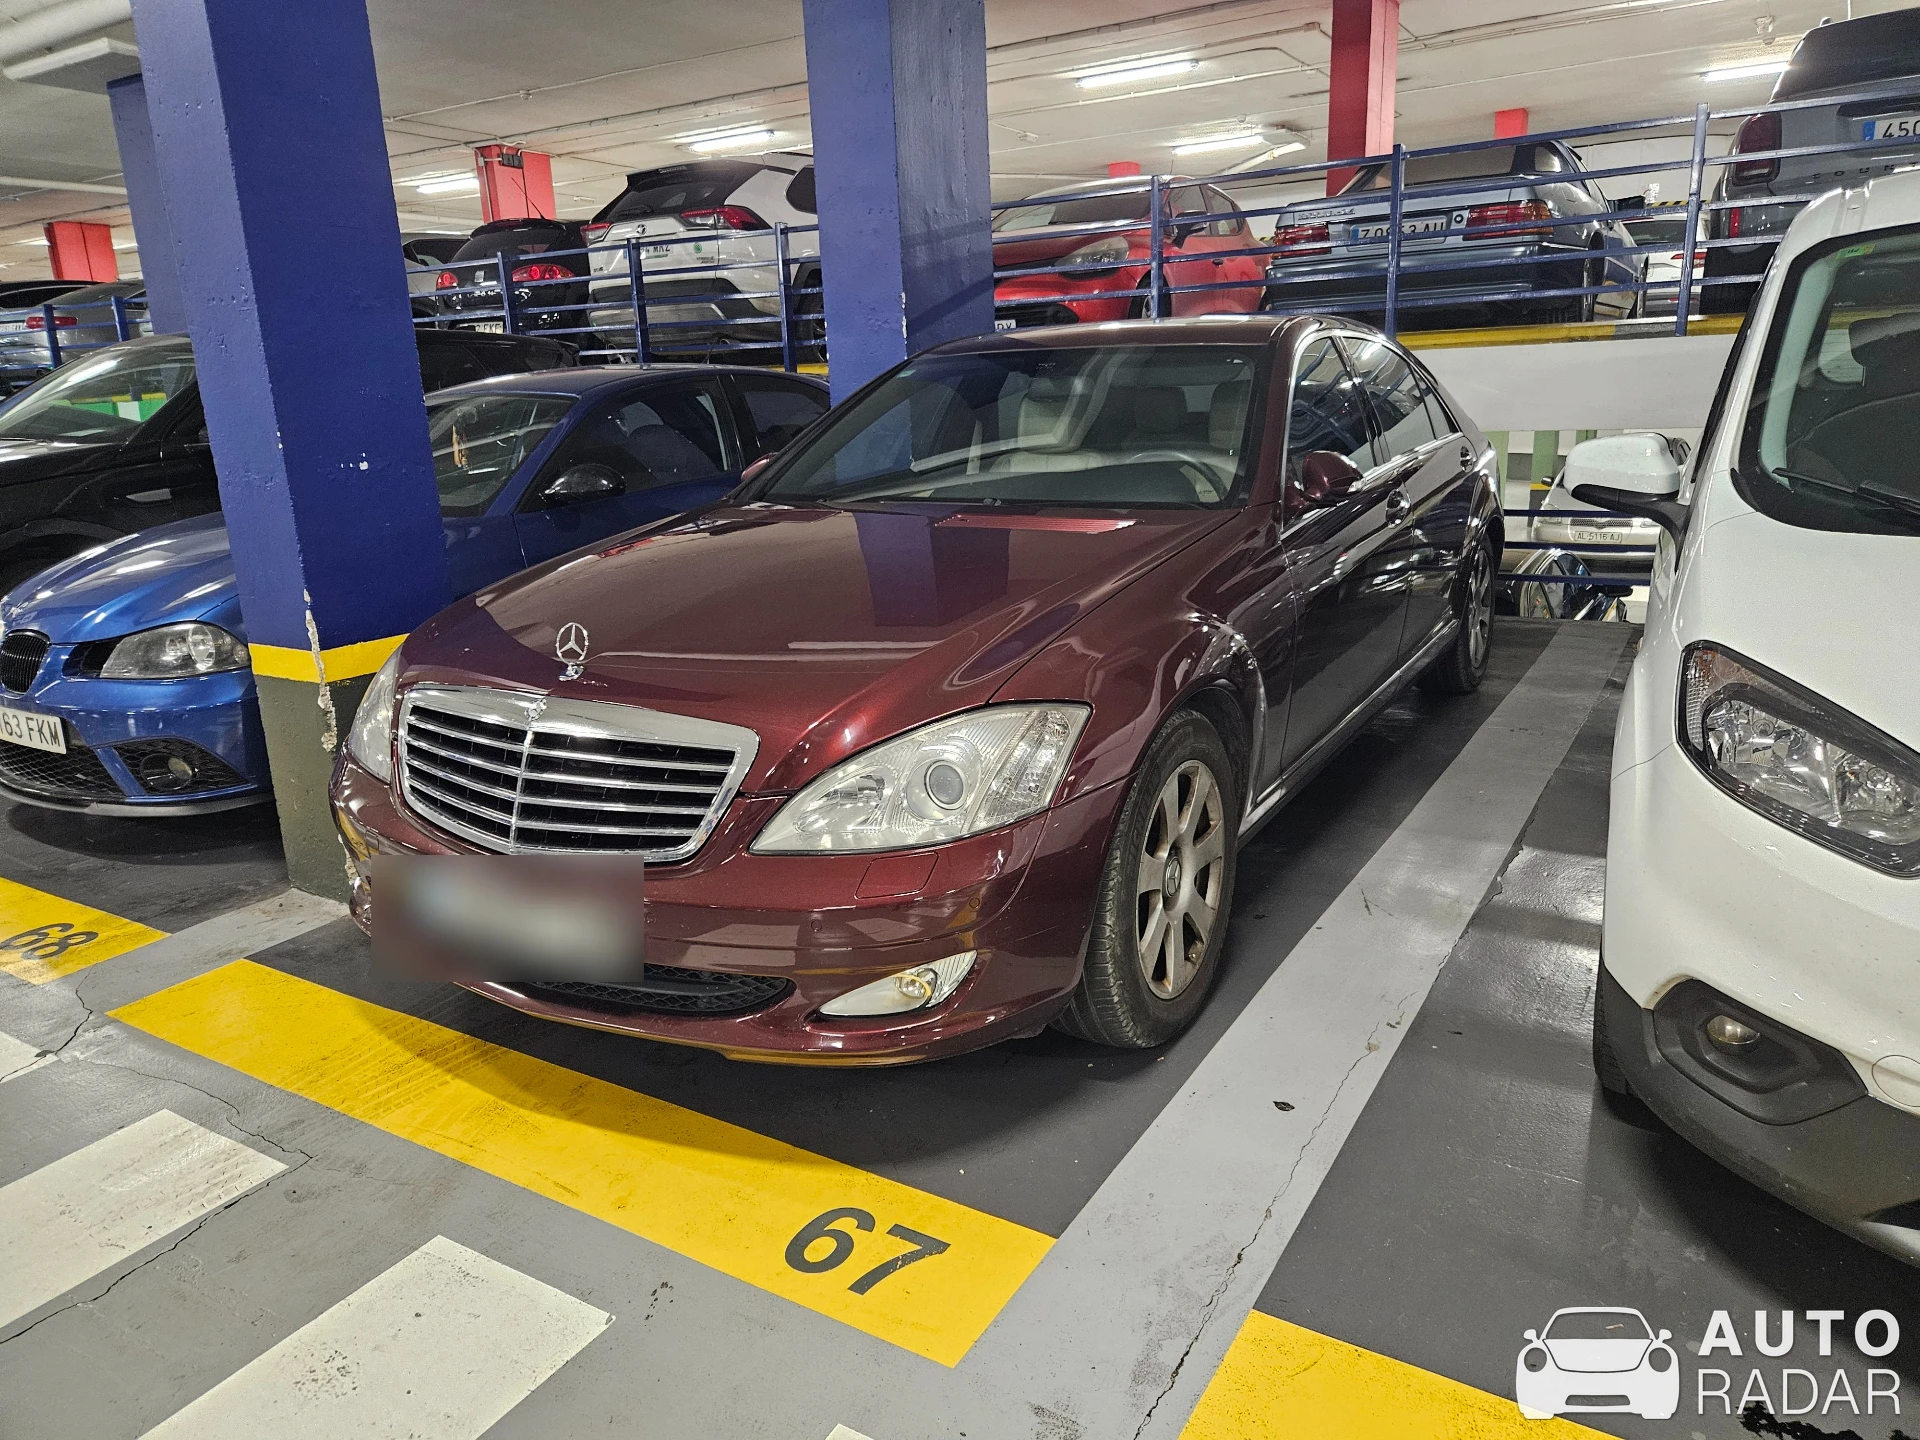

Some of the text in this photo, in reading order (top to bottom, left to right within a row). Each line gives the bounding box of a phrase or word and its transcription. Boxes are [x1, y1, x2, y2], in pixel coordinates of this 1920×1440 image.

[0, 712, 61, 747] 63 FKM
[0, 922, 99, 960] 68
[784, 1207, 952, 1296] 67
